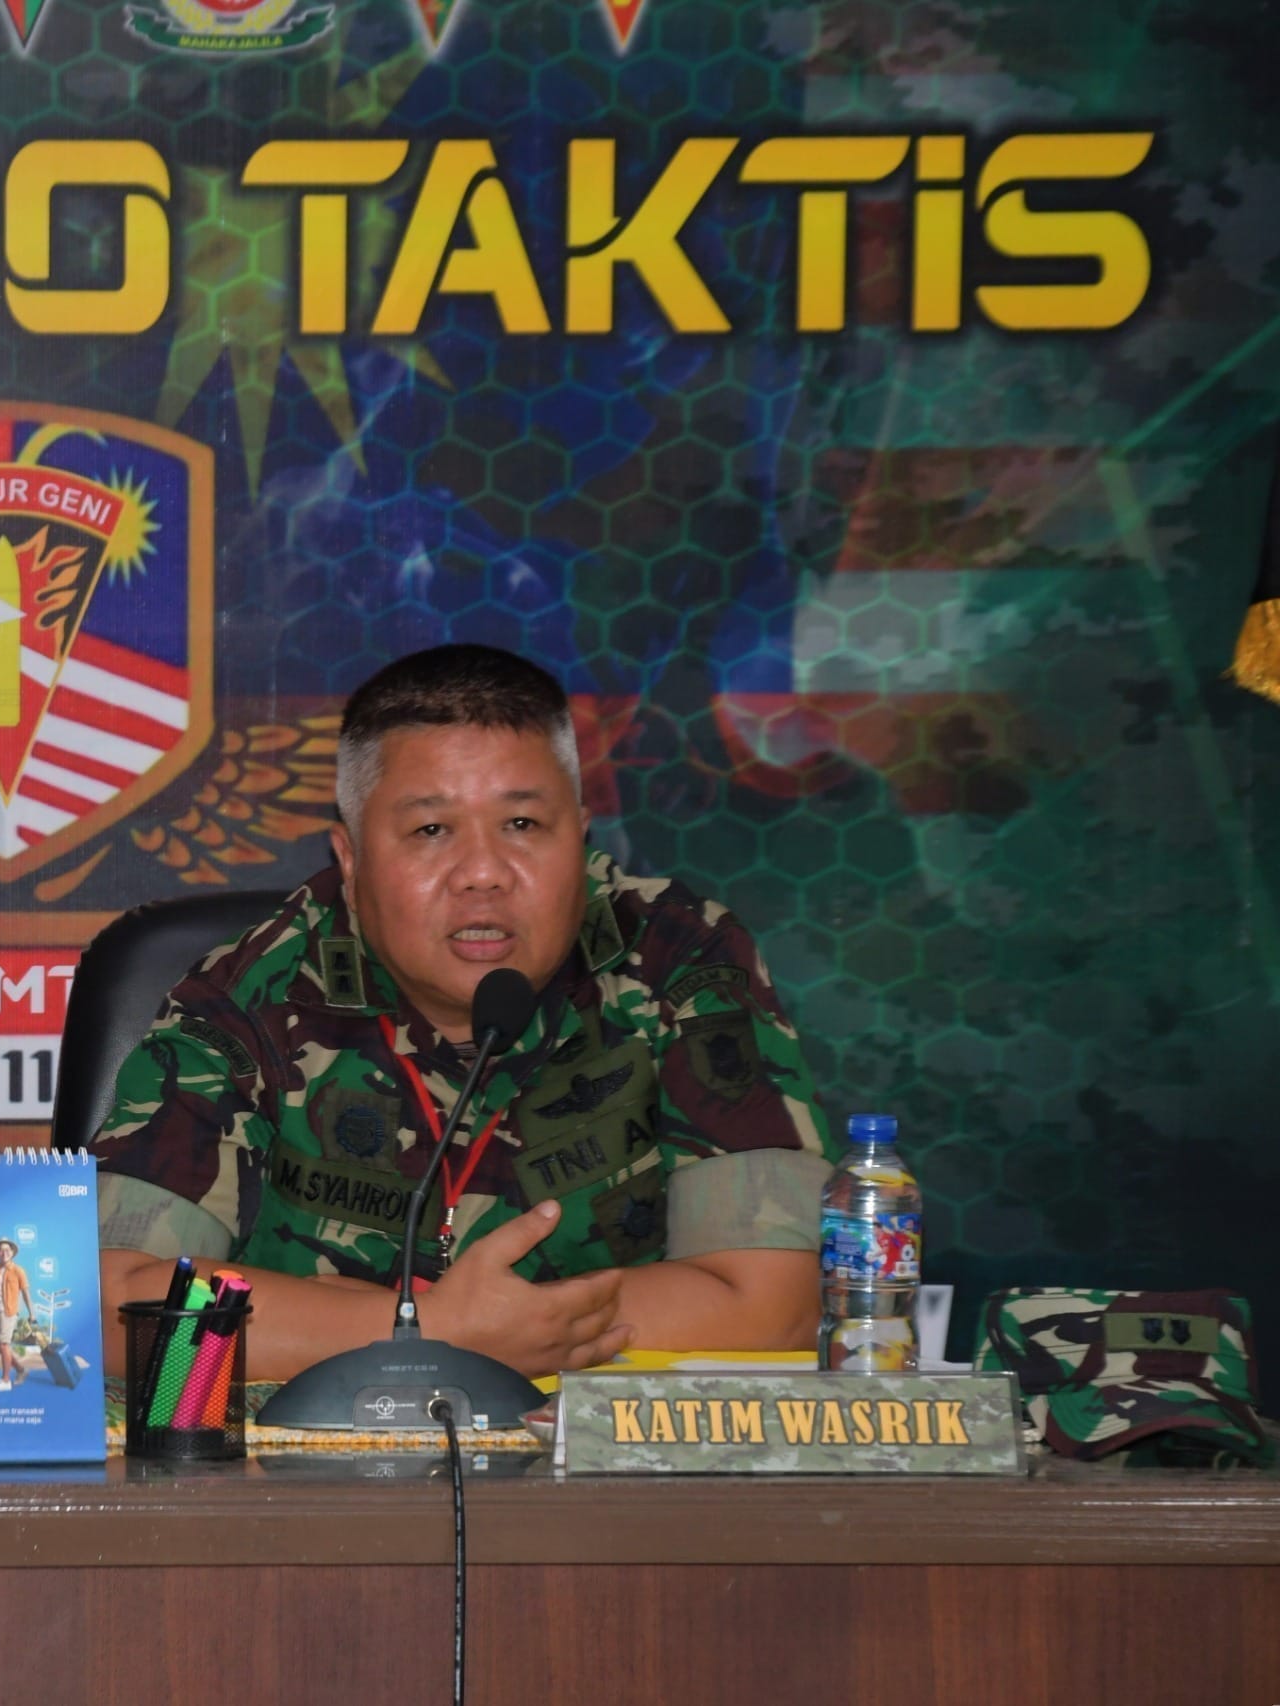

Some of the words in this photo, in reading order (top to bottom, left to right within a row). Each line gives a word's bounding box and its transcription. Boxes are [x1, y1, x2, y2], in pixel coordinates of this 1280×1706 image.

[38, 482, 111, 525] GENI
[1, 1050, 53, 1103] 11
[528, 1135, 607, 1190] TNI
[611, 1400, 765, 1444] KATIM
[776, 1400, 970, 1445] WASRIK
